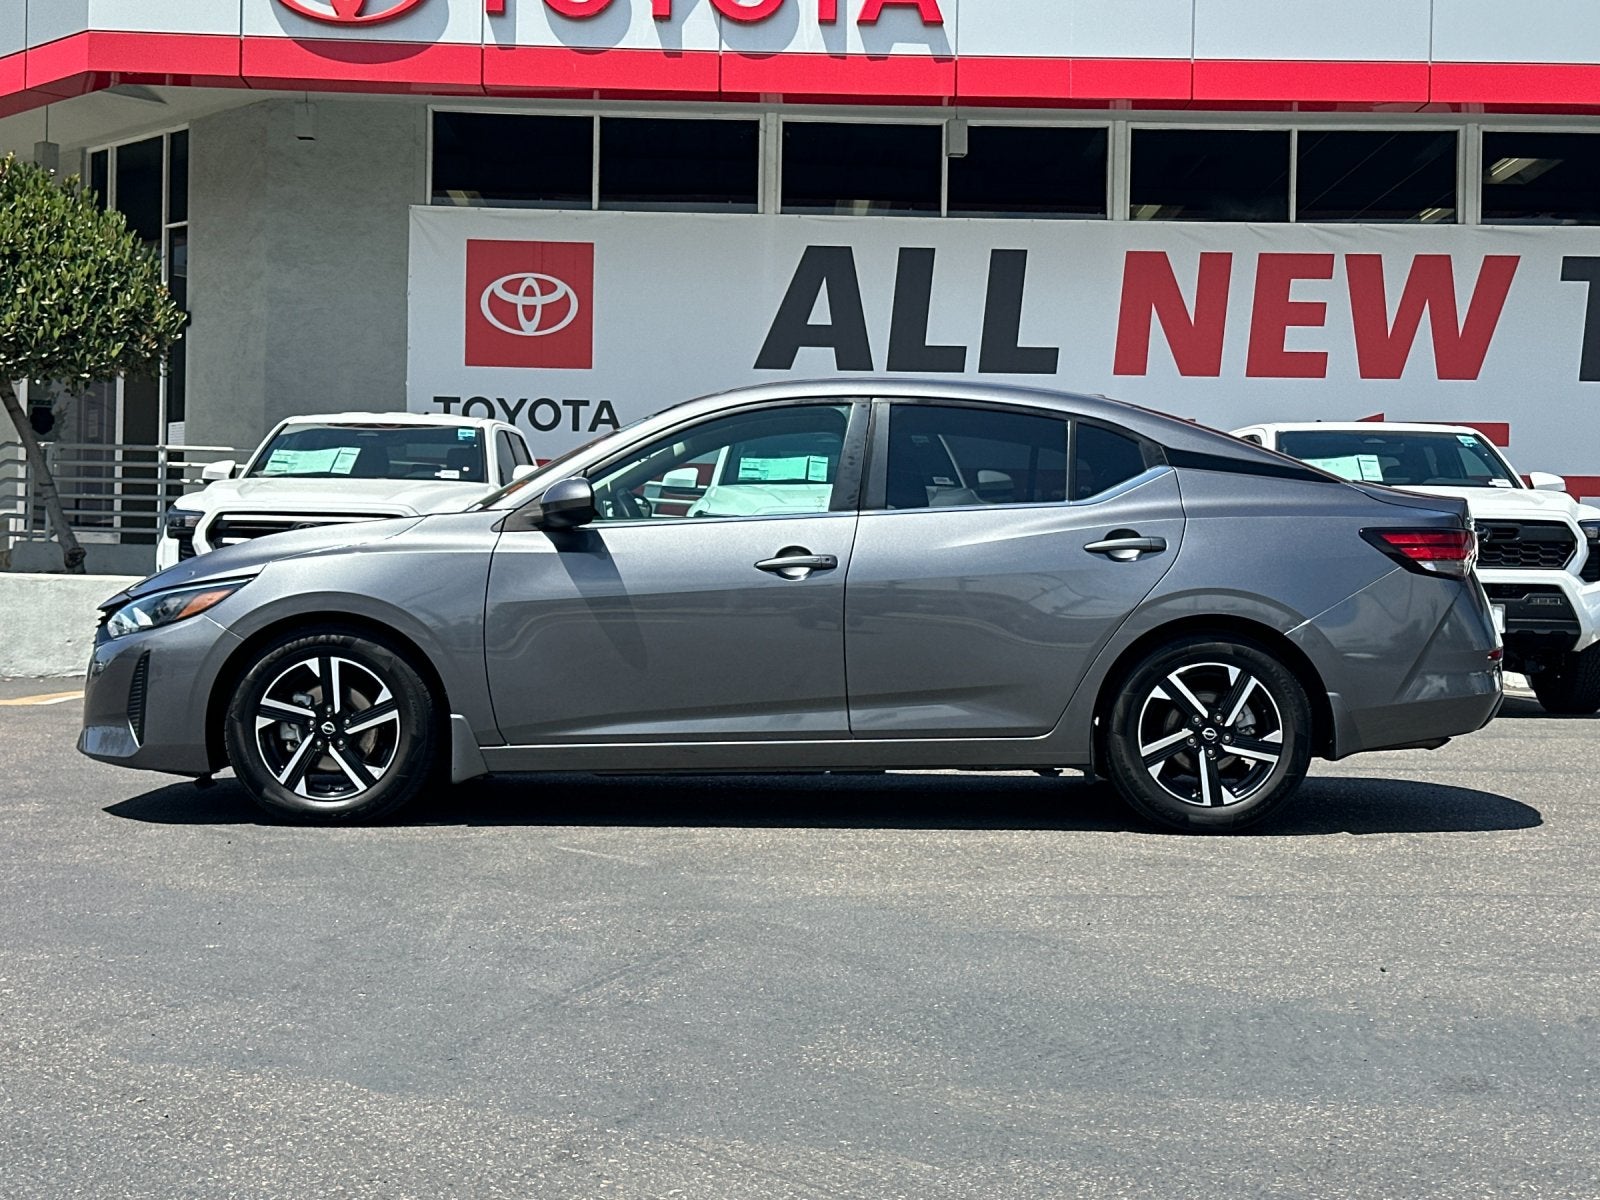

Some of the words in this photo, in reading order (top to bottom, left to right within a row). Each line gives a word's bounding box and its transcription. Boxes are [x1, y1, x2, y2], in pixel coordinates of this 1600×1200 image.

[753, 245, 1060, 374] ALL
[1113, 251, 1520, 380] NEW
[433, 396, 620, 432] TOYOTA
